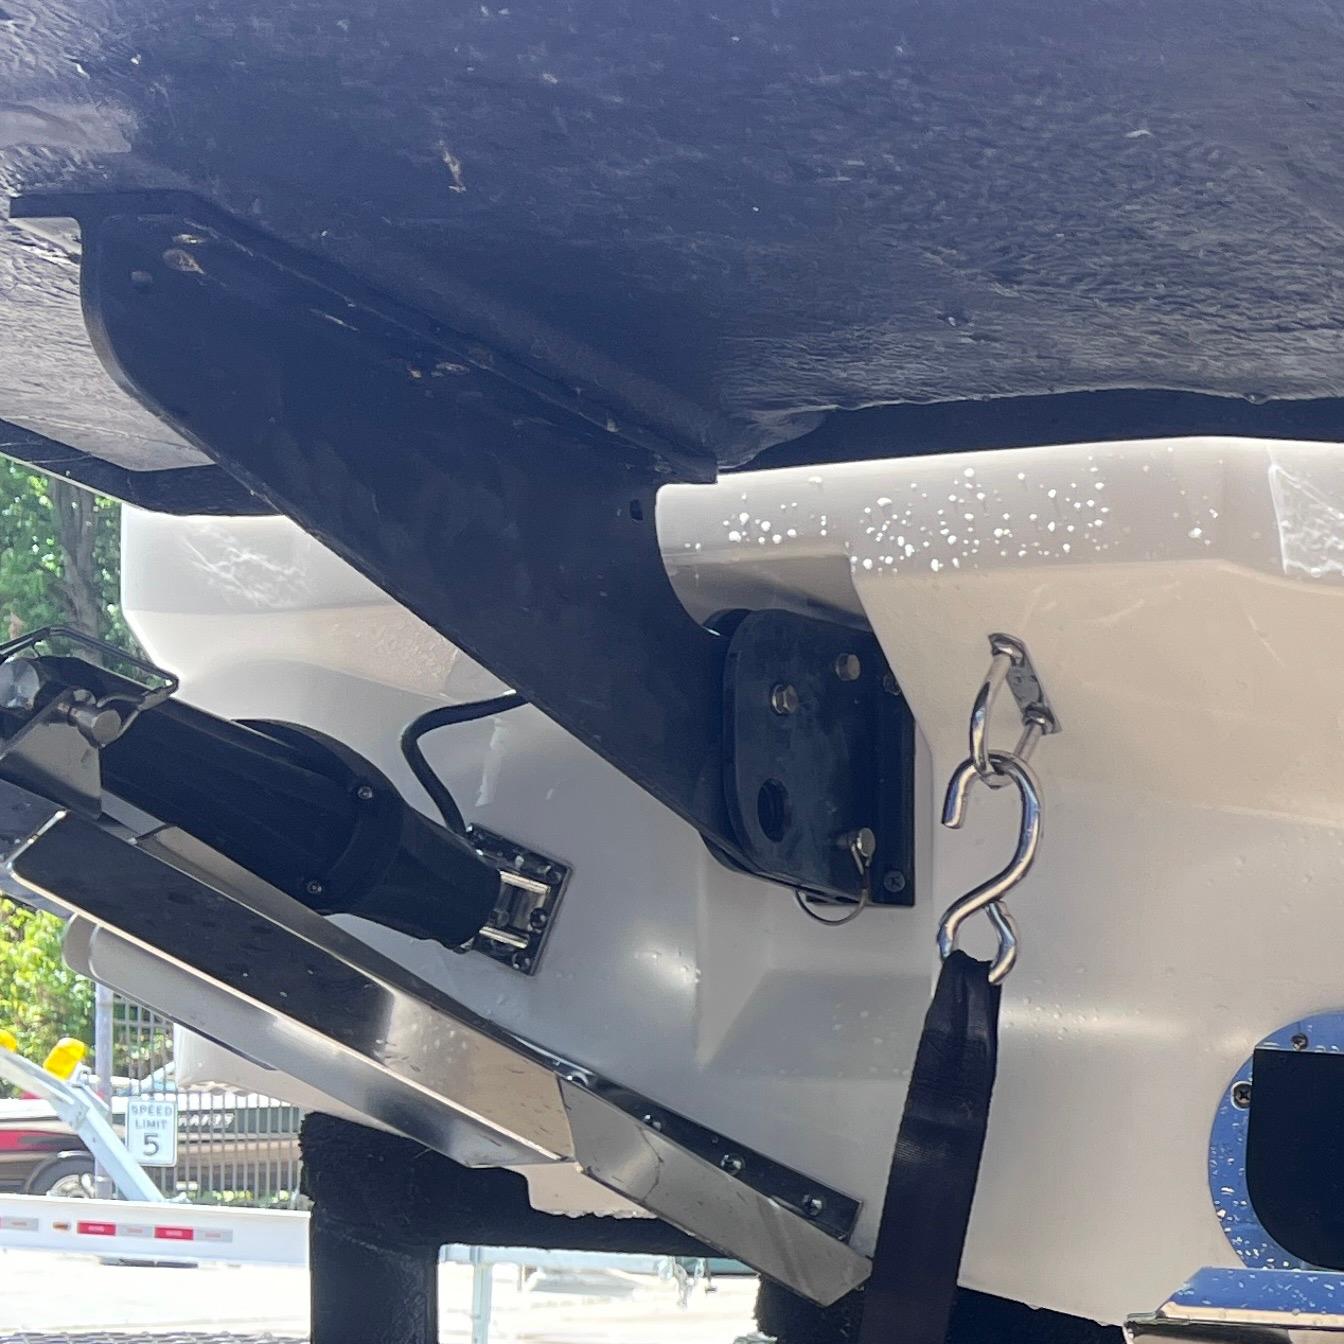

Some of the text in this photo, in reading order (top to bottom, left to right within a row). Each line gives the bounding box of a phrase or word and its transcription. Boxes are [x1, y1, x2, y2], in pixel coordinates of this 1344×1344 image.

[131, 1104, 172, 1116] SPEED
[135, 1119, 168, 1129] LIMIT
[143, 1132, 160, 1156] 5
